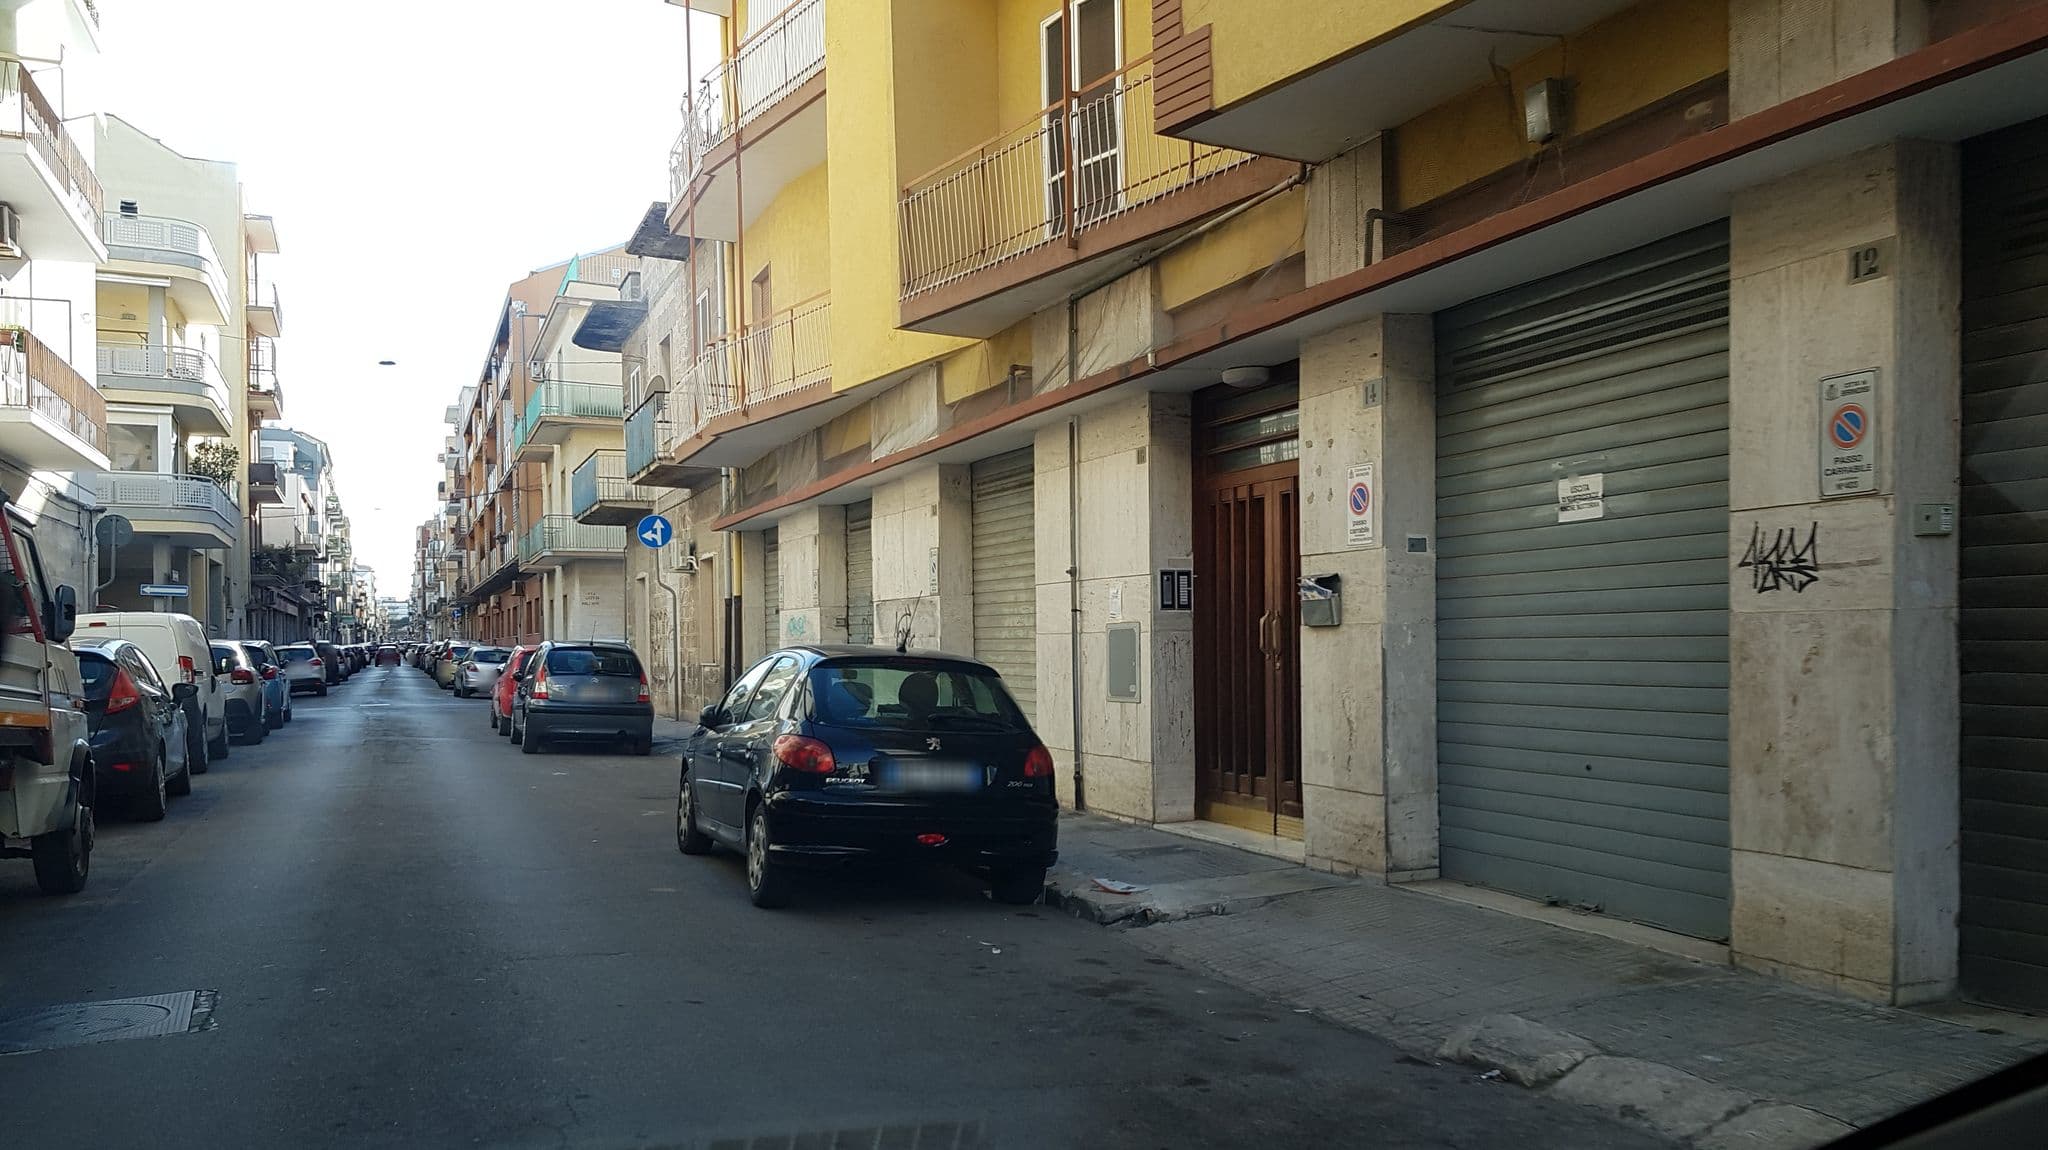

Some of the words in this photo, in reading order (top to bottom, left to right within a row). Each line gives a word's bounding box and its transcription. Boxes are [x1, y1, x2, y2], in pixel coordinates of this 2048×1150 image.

[1853, 247, 1880, 279] 12
[1365, 383, 1377, 405] 14
[1833, 454, 1863, 464] PASSO
[1824, 464, 1872, 476] CARRABILE
